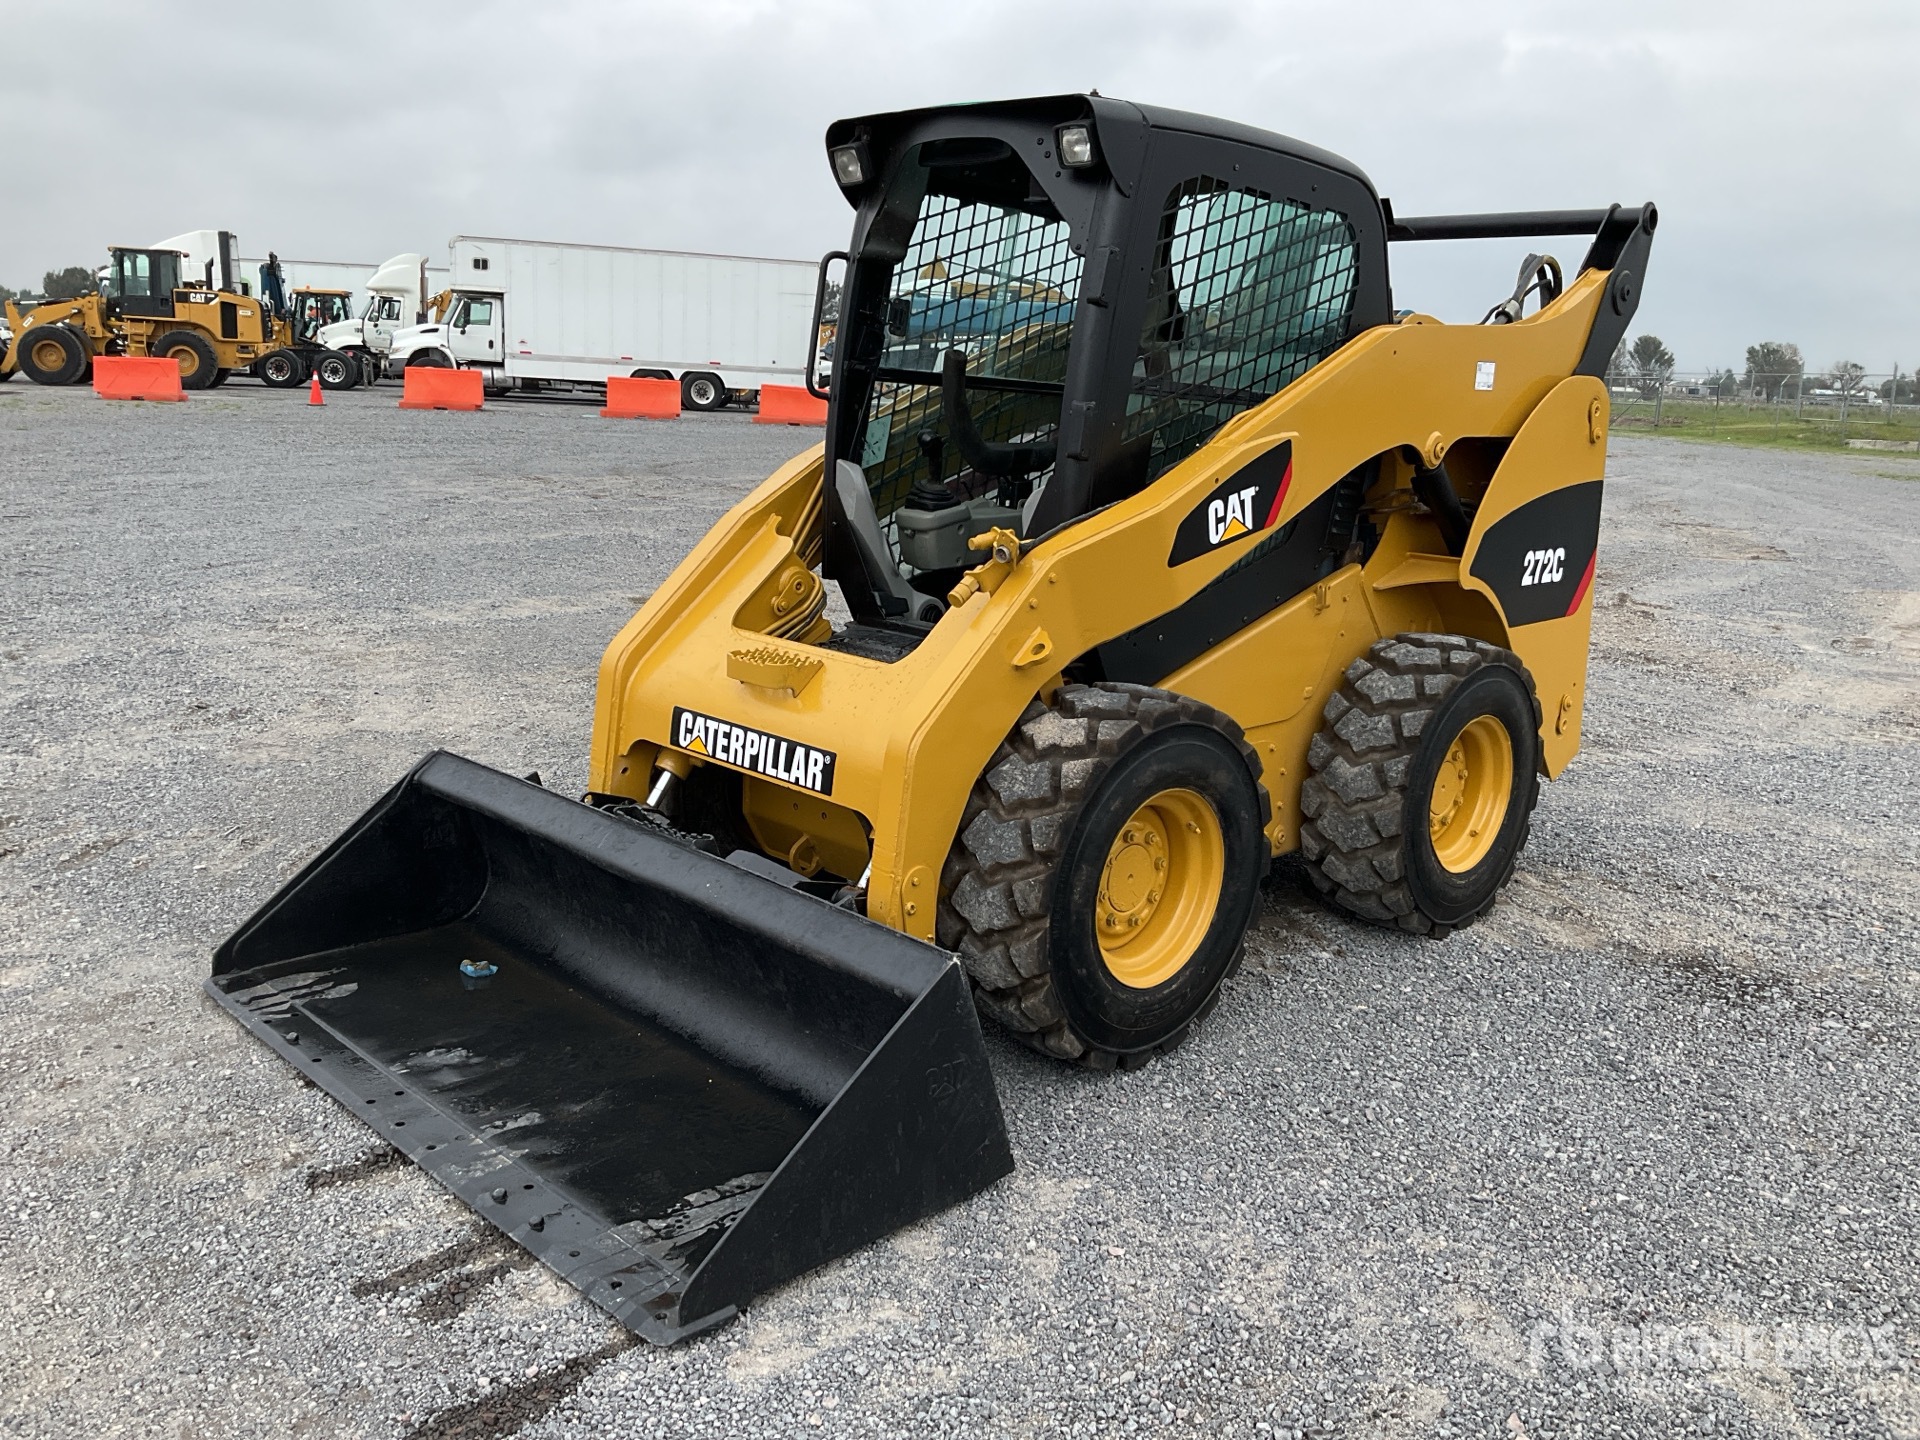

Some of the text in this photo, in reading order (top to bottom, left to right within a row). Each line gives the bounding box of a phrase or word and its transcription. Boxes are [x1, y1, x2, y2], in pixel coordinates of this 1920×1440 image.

[190, 293, 206, 303] CAT
[1208, 486, 1256, 545] CAT
[1521, 547, 1566, 587] 272C
[678, 711, 825, 792] CATERPILLAR
